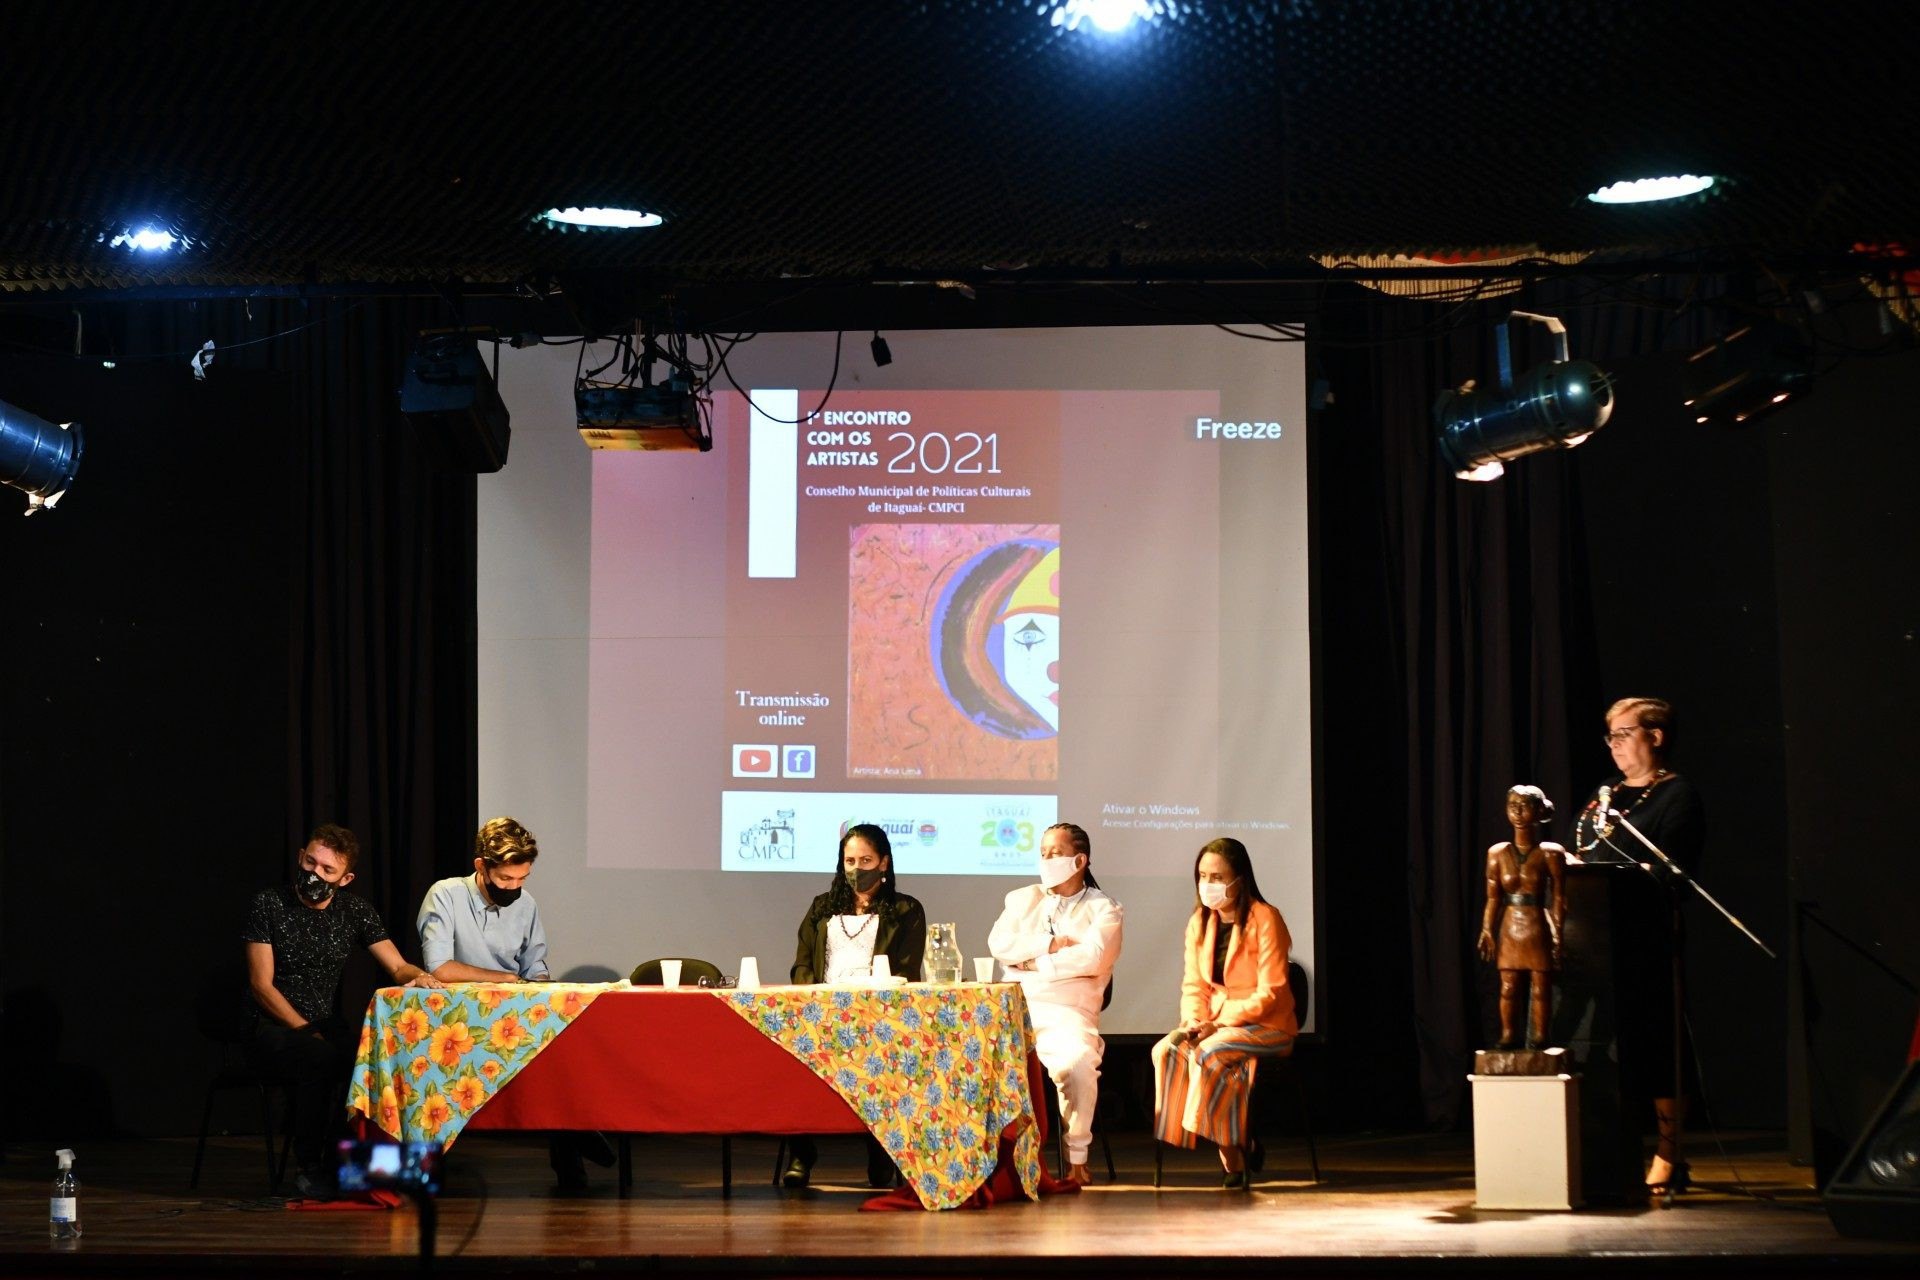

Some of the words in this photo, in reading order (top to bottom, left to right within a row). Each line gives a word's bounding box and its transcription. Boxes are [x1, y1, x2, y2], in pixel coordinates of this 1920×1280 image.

[824, 411, 911, 425] ENCONTRO
[1197, 418, 1281, 439] Freeze
[807, 431, 844, 446] COM
[848, 431, 871, 446] OS
[807, 452, 878, 466] ARTISTAS
[888, 432, 1001, 473] 2021
[805, 485, 856, 497] Conselho
[858, 486, 913, 499] Municipal
[916, 486, 930, 497] de
[932, 485, 978, 497] Políticas
[980, 486, 1031, 497] Culturais
[868, 502, 882, 513] de
[928, 503, 965, 513] CMPCI
[735, 690, 830, 706] Transmissão
[759, 710, 806, 725] online
[1103, 803, 1134, 815] Ativar
[1139, 806, 1147, 815] o
[1150, 803, 1200, 815] Windows
[738, 845, 795, 860] CMPCI
